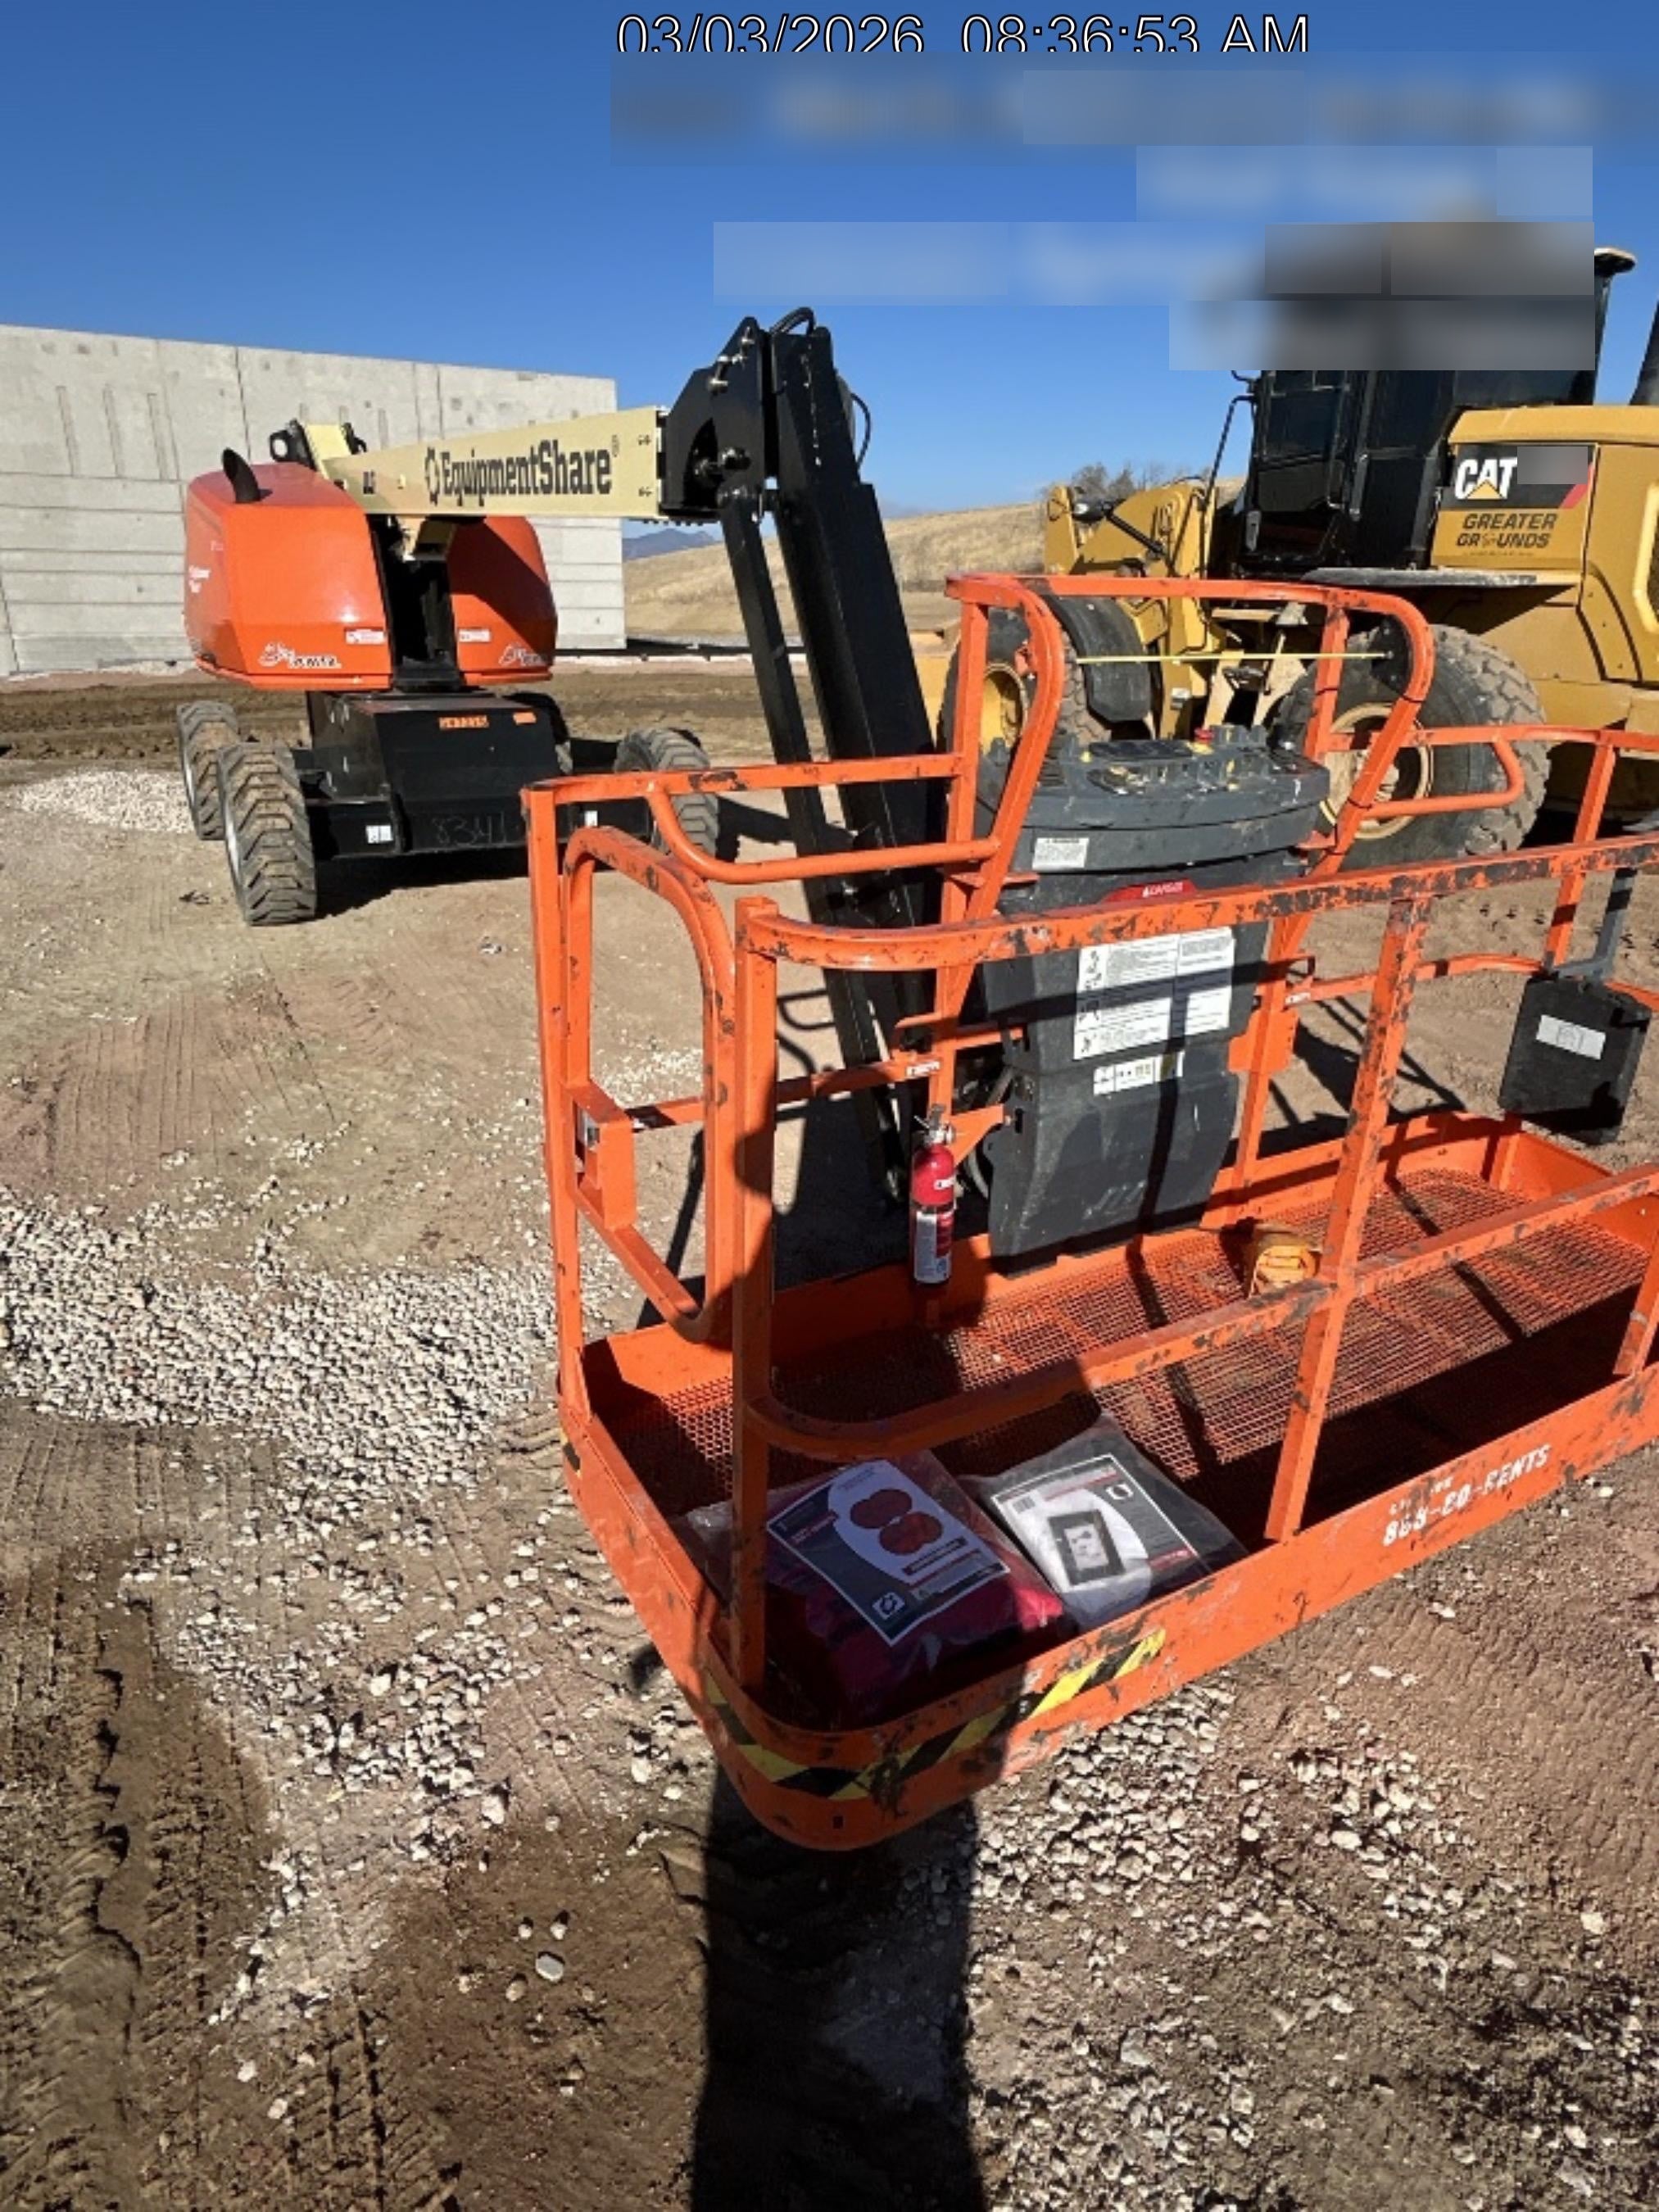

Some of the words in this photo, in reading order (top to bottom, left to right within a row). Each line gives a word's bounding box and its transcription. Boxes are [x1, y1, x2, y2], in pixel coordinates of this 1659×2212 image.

[440, 439, 612, 507] EquipmentShare
[1454, 457, 1518, 500] CAT
[1462, 513, 1559, 529] GREATER
